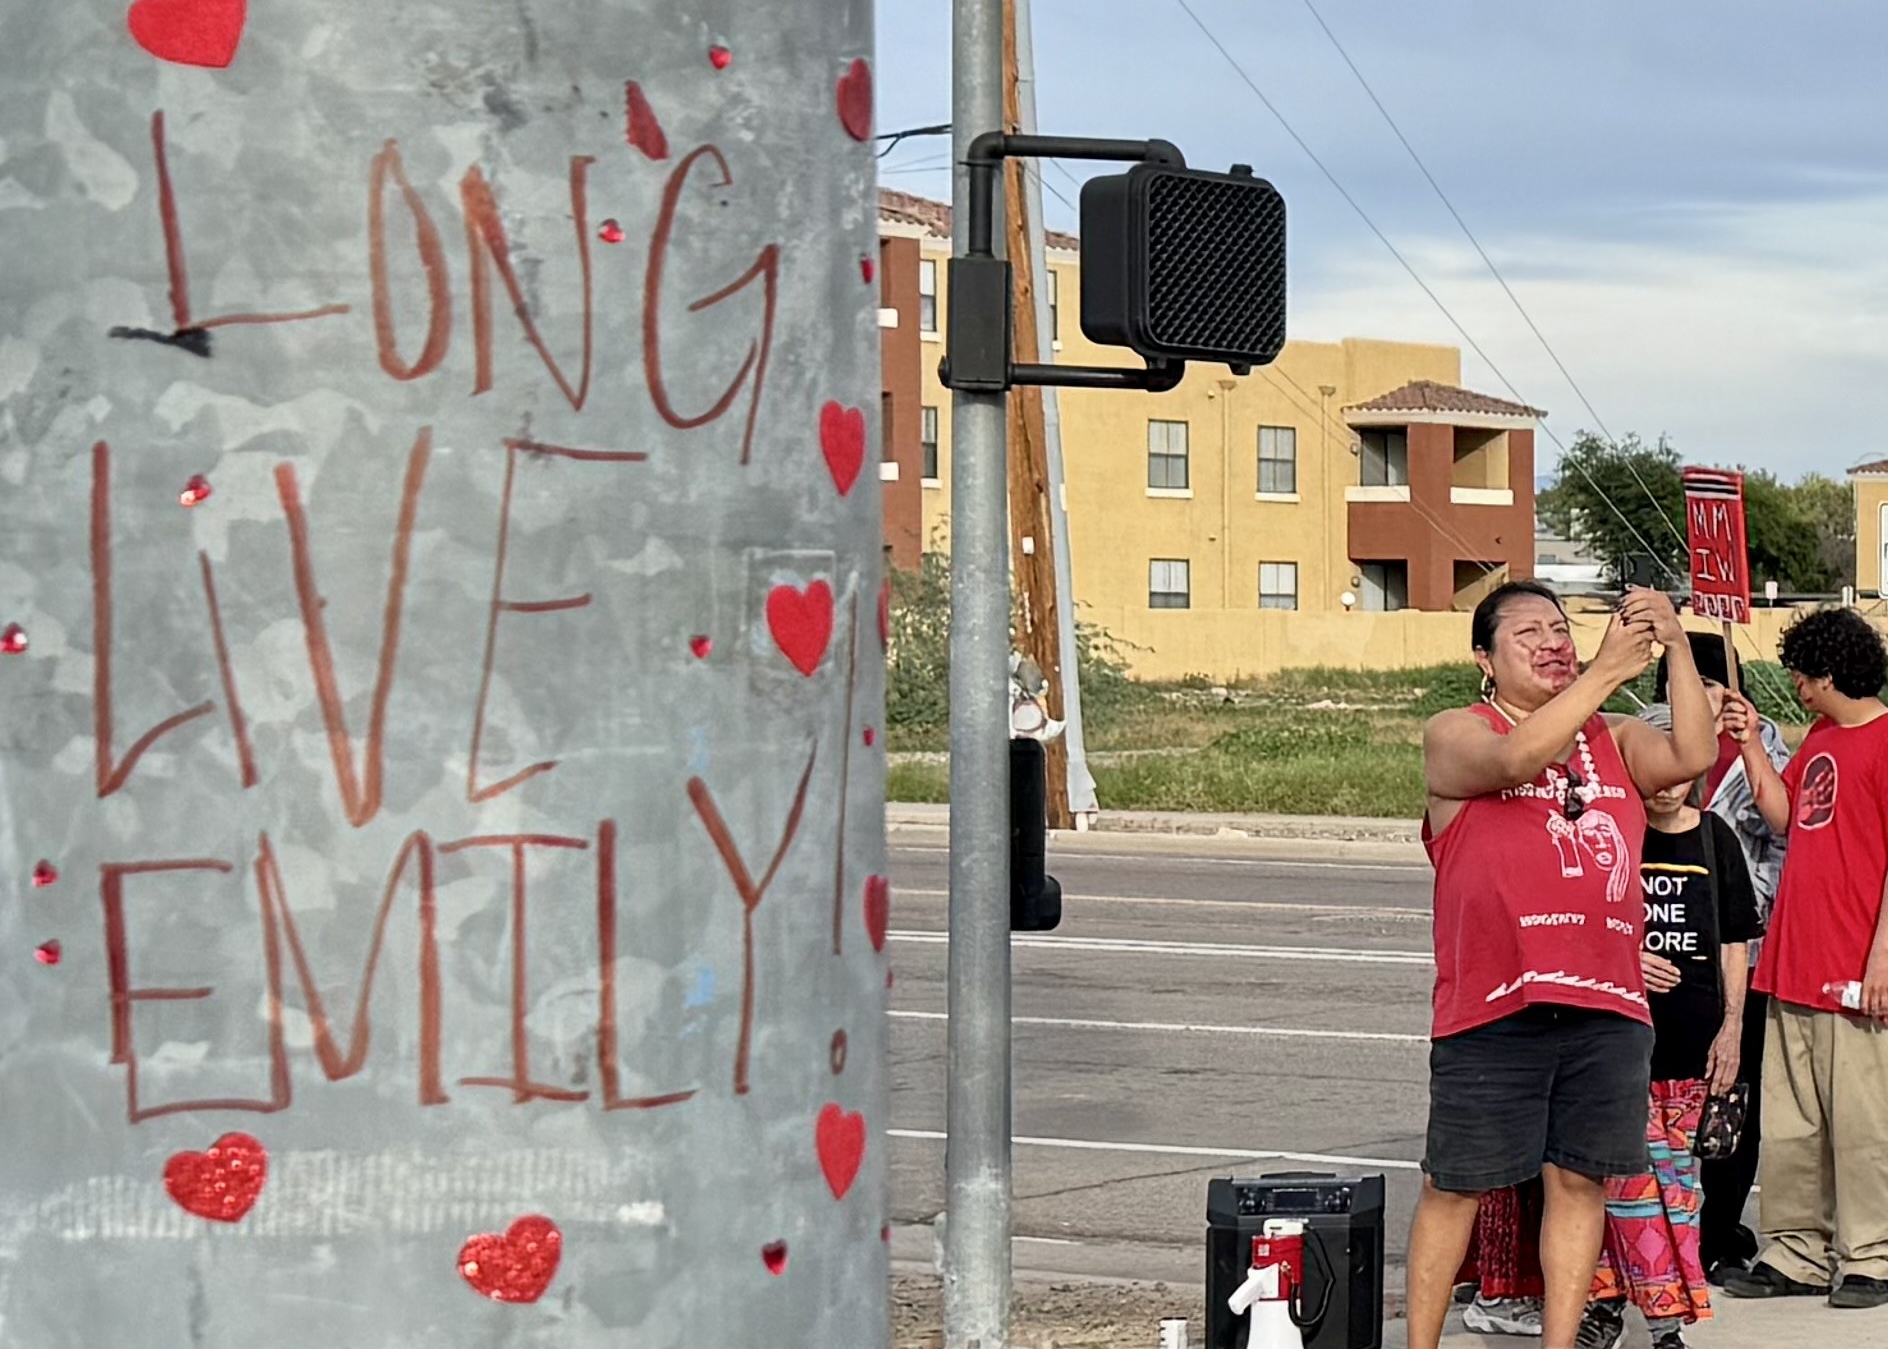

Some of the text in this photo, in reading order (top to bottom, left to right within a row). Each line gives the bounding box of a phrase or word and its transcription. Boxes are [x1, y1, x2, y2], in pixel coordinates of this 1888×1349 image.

[148, 109, 780, 466] LONG
[1692, 502, 1732, 541] MM
[92, 427, 647, 826] LIVE
[1639, 875, 1689, 896] NOT
[1644, 930, 1699, 952] ORE
